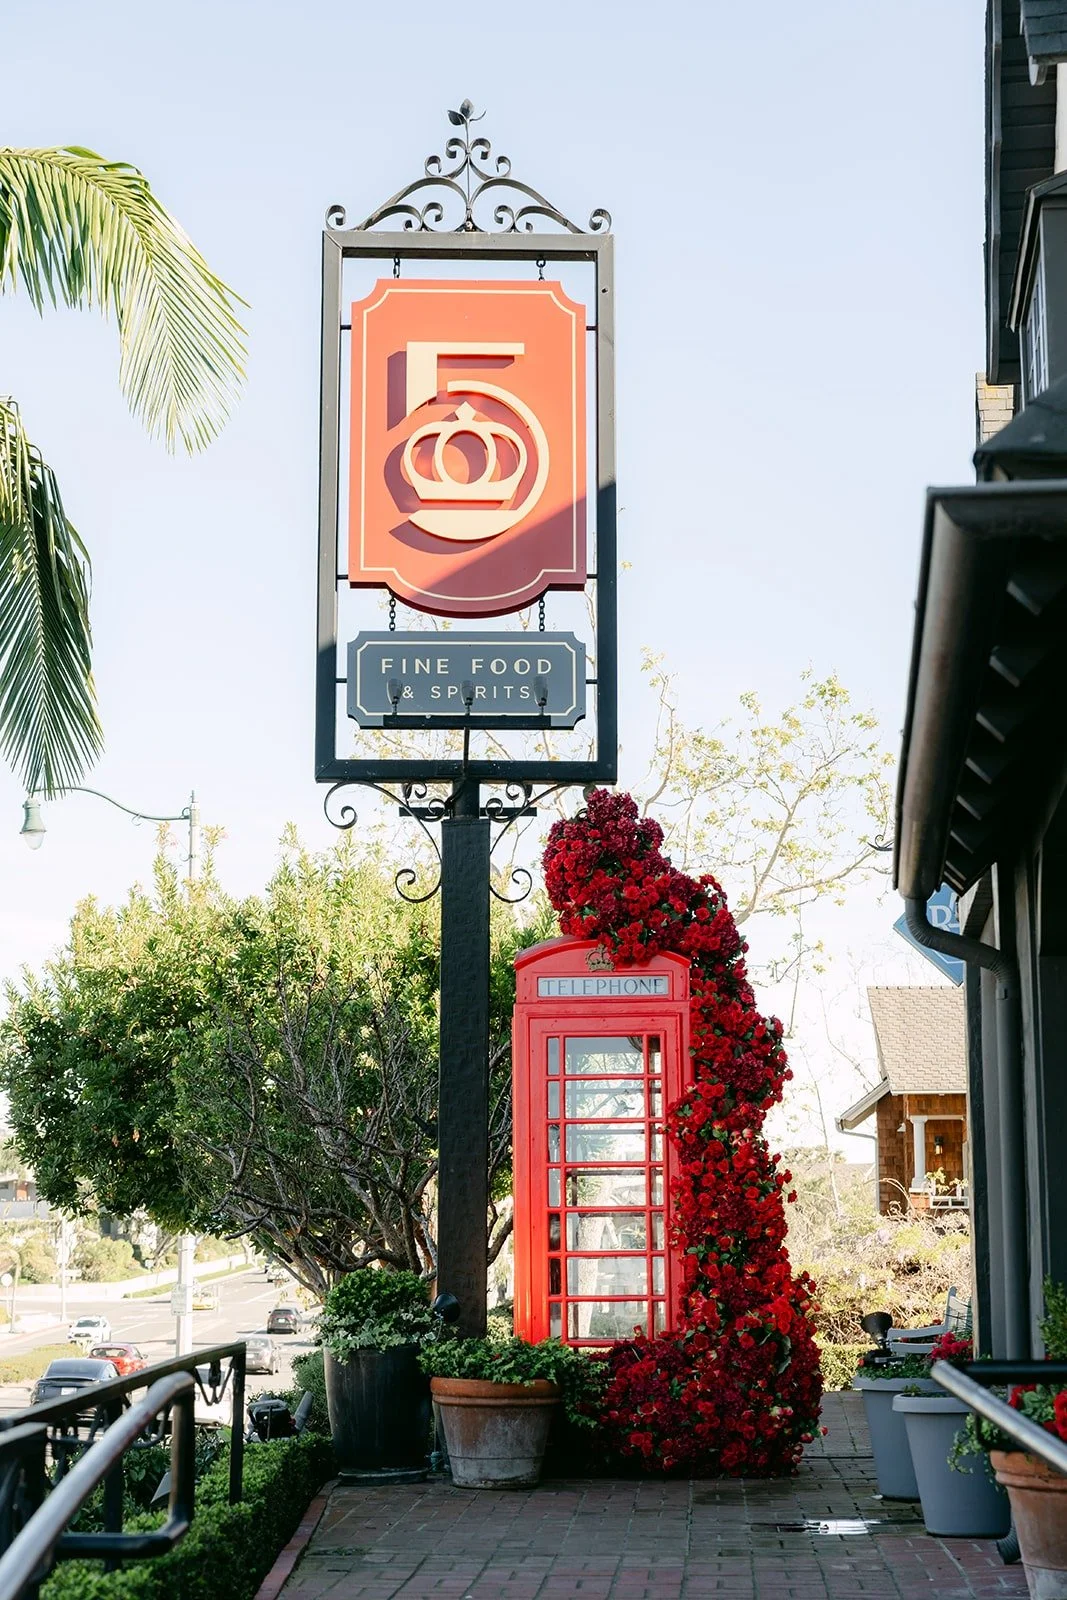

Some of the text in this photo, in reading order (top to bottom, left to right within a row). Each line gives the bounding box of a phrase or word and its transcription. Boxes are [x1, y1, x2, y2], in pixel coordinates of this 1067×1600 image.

[381, 658, 552, 675] FINE FOOD
[402, 686, 531, 699] & SPRITS
[541, 978, 664, 996] TELEPHONE
